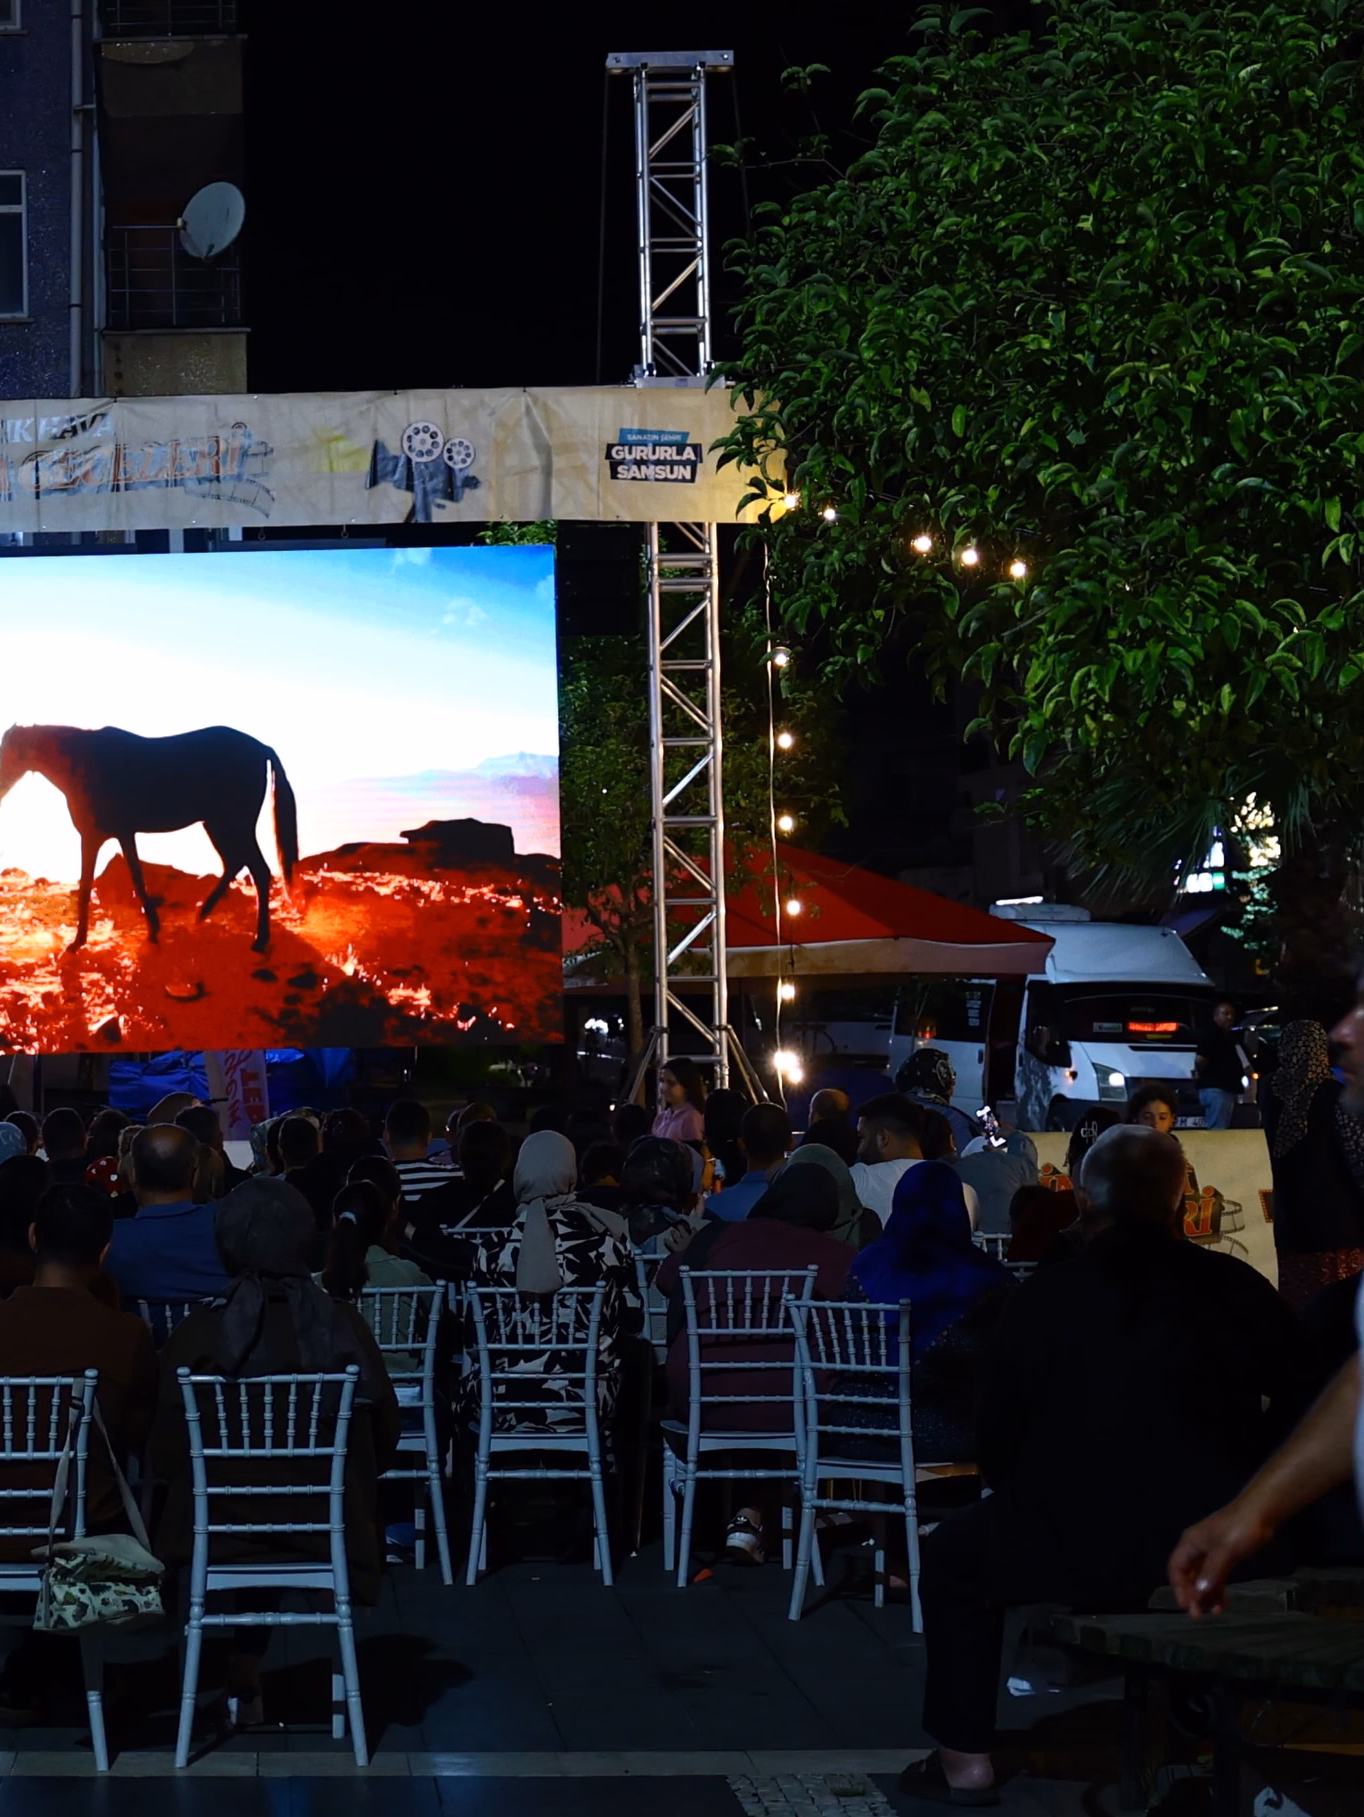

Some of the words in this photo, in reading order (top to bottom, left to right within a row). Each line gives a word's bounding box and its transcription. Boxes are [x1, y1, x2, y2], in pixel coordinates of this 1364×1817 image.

[38, 412, 116, 442] HAVA
[611, 445, 696, 461] GURURLA
[616, 464, 692, 480] SAMSUN
